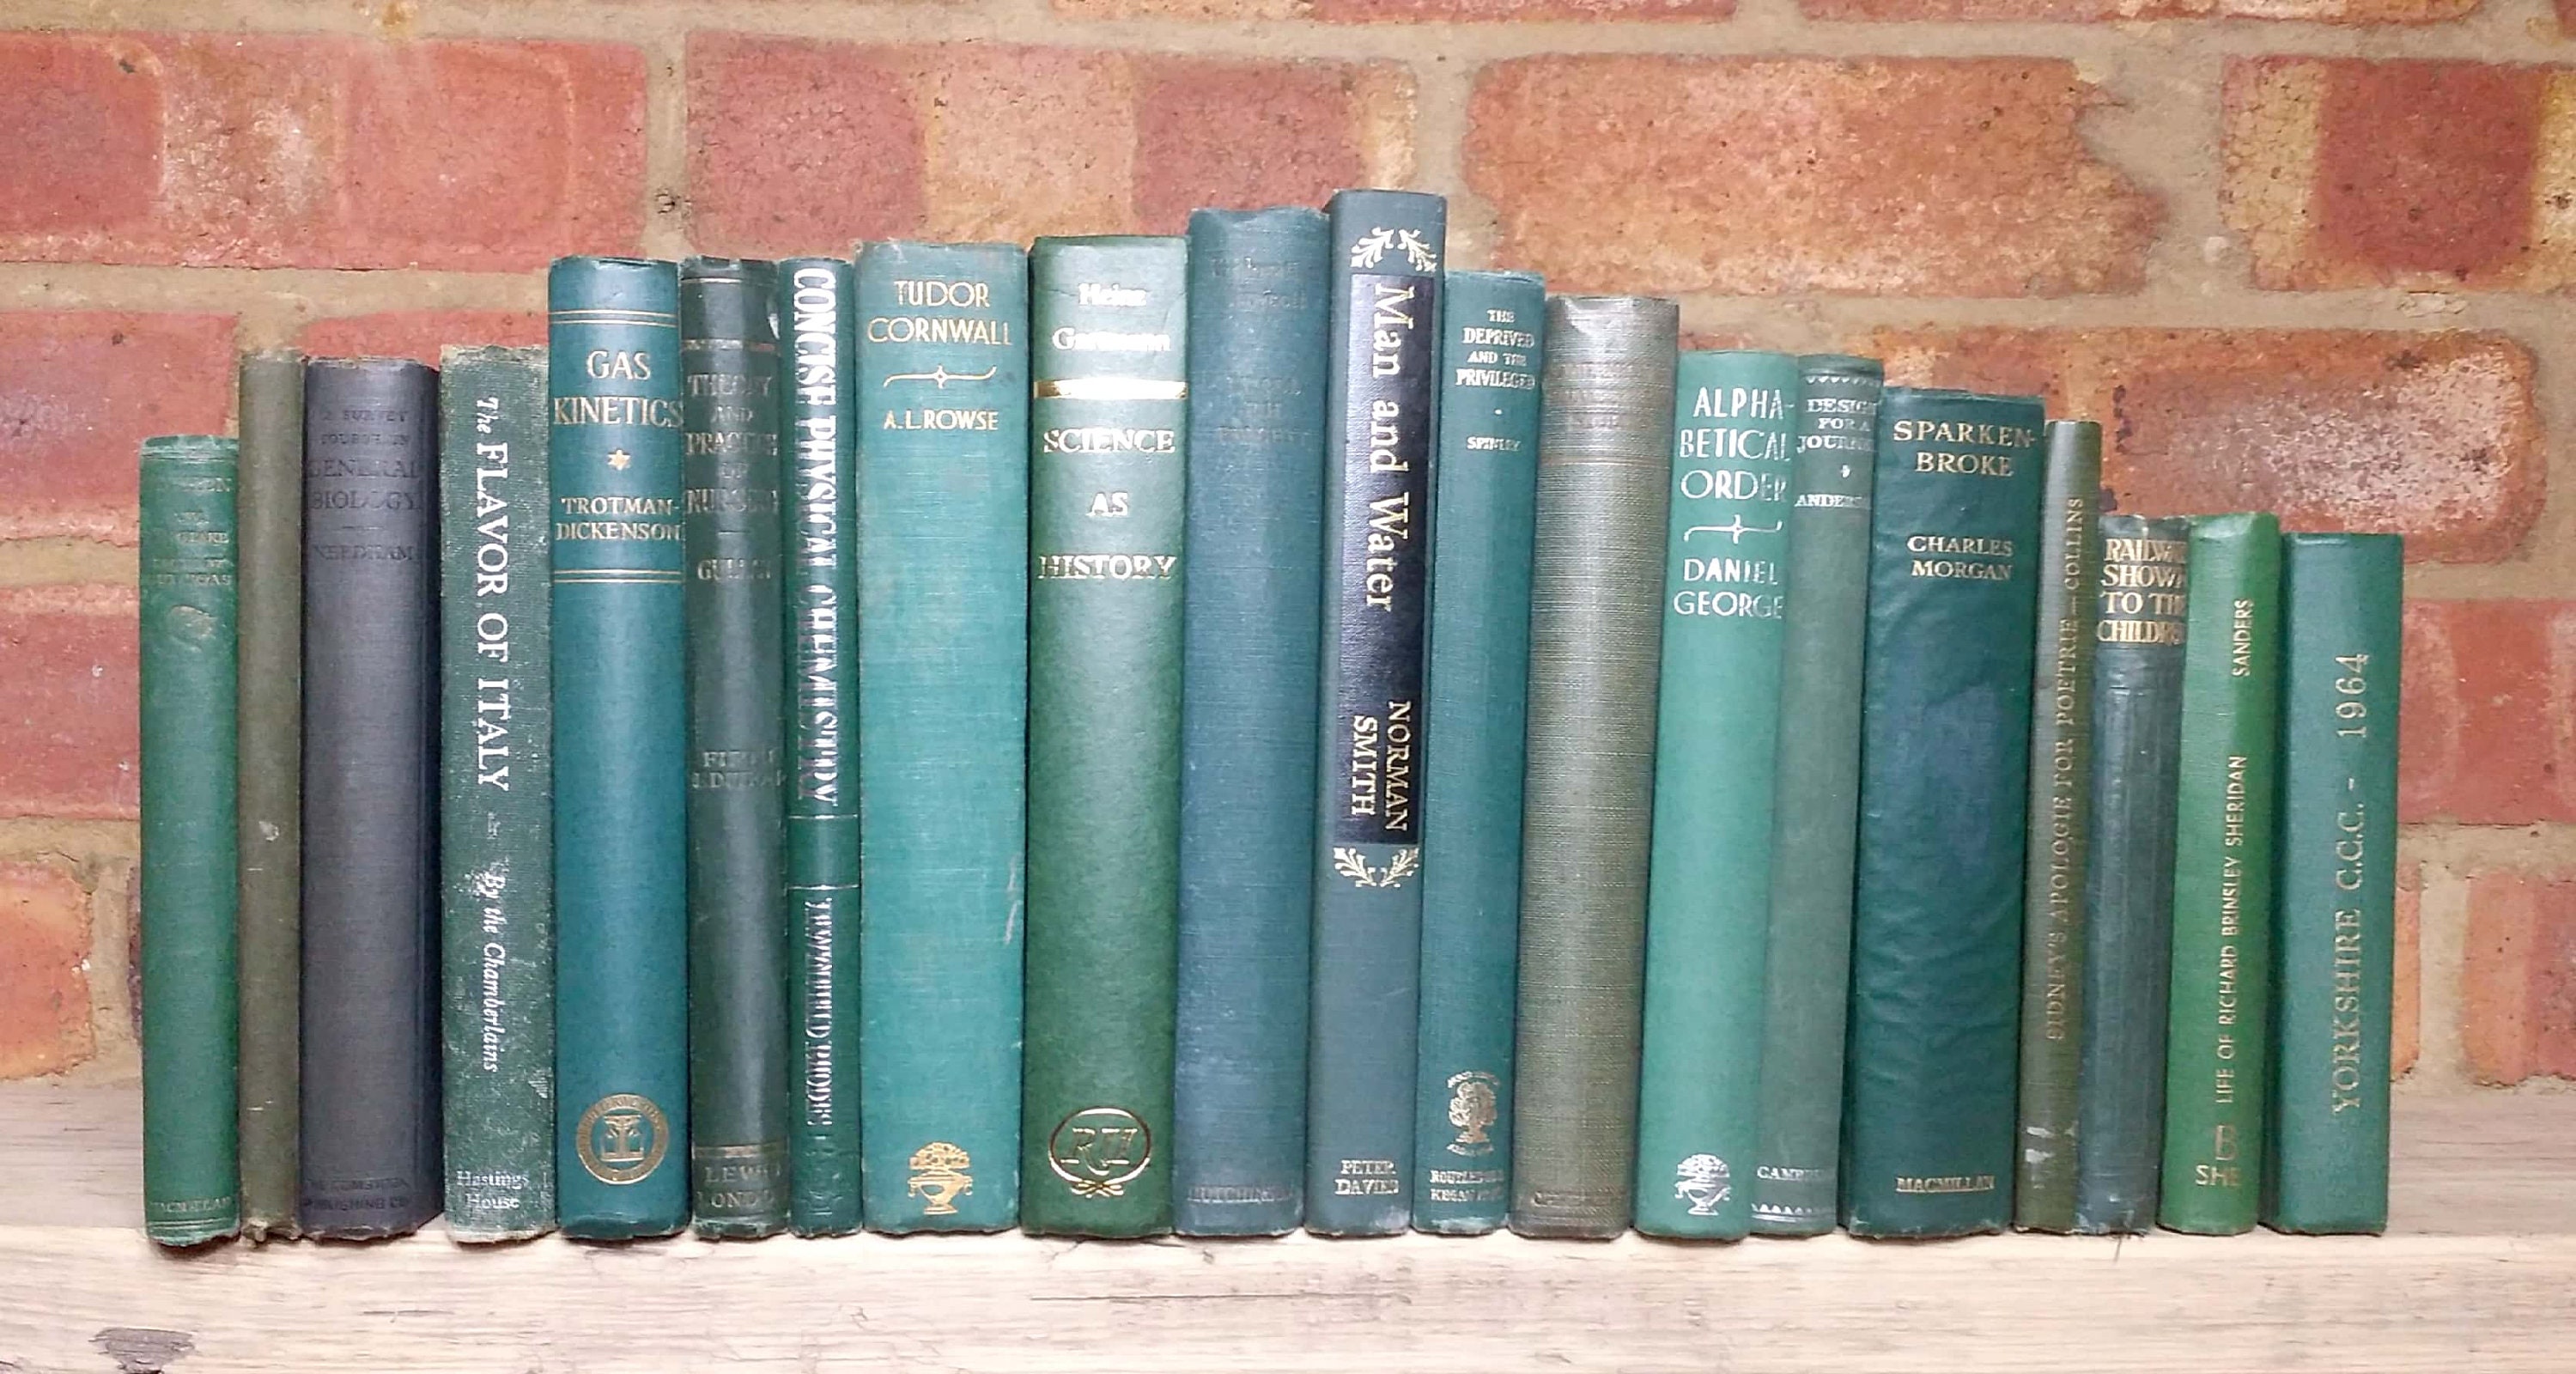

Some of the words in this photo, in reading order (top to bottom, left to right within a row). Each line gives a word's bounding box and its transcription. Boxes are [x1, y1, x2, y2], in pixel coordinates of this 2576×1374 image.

[894, 280, 990, 308] TUDOR
[1373, 283, 1415, 379] Man
[1485, 308, 1516, 324] THE
[793, 267, 838, 406] CONCISE
[867, 318, 1014, 347] CORNWALL
[1461, 326, 1535, 349] DEPRIVED
[586, 350, 651, 380] GAS
[1467, 350, 1498, 364] AND
[1502, 352, 1528, 367] THE
[1454, 368, 1535, 390] PRIVILEGED
[476, 397, 499, 435] The
[553, 396, 685, 428] KINETICS
[1692, 386, 1795, 420] ALPHA-
[1368, 400, 1410, 473] and
[1817, 417, 1855, 432] FOR
[1893, 419, 2036, 448] SPARKEN-
[1042, 429, 1177, 454] SCIENCE
[1679, 428, 1791, 462] BETICAL
[1915, 451, 2015, 477] BROKE
[310, 489, 421, 510] BIOLOGY
[793, 416, 838, 577] PHYSICAL
[1680, 469, 1788, 502] ORDER
[476, 441, 508, 598] FLAVOR
[560, 496, 679, 516] TROTMAN-
[1085, 491, 1130, 517] AS
[556, 521, 686, 541] DICKENSON
[1906, 536, 2014, 556] CHARLES
[2063, 496, 2084, 591] COLLINS
[1037, 555, 1178, 580] HISTORY
[1364, 492, 1410, 612] Water
[1683, 557, 1778, 586] DANIEL
[1911, 559, 2013, 581] MORGAN
[1673, 590, 1784, 619] GEORGE
[2099, 591, 2144, 615] TO
[477, 611, 508, 663] OF
[2232, 598, 2254, 678] SANDERS
[2055, 618, 2078, 727] POETRIE
[797, 584, 838, 807] CHEMISTRY
[2336, 652, 2371, 739] 1964
[477, 678, 510, 792] ITALY
[1351, 714, 1378, 816] SMITH
[1384, 700, 1413, 832] NORMAN
[2053, 738, 2074, 788] FOR
[2225, 755, 2248, 847] SHERIDAN
[2050, 796, 2074, 922] APOLOGIE
[2336, 800, 2366, 890] C.C.C.
[480, 867, 507, 899] By
[2221, 855, 2244, 937] BRINSLEY
[482, 906, 507, 934] the
[2219, 945, 2239, 1025] RICHARD
[482, 942, 507, 1073] Chamberlains
[2331, 907, 2362, 1116] YORKSHIRE
[2217, 1034, 2236, 1061] OF
[2215, 1067, 2234, 1103] LIFE
[456, 1170, 529, 1190] Hastings
[1340, 1159, 1397, 1176] PETER
[1429, 1169, 1504, 1184] ROUTLE
[2195, 1164, 2241, 1187] SHE
[1334, 1178, 1400, 1196] DAVIES
[1894, 1175, 1996, 1194] MACMILLAN
[465, 1193, 520, 1209] House
